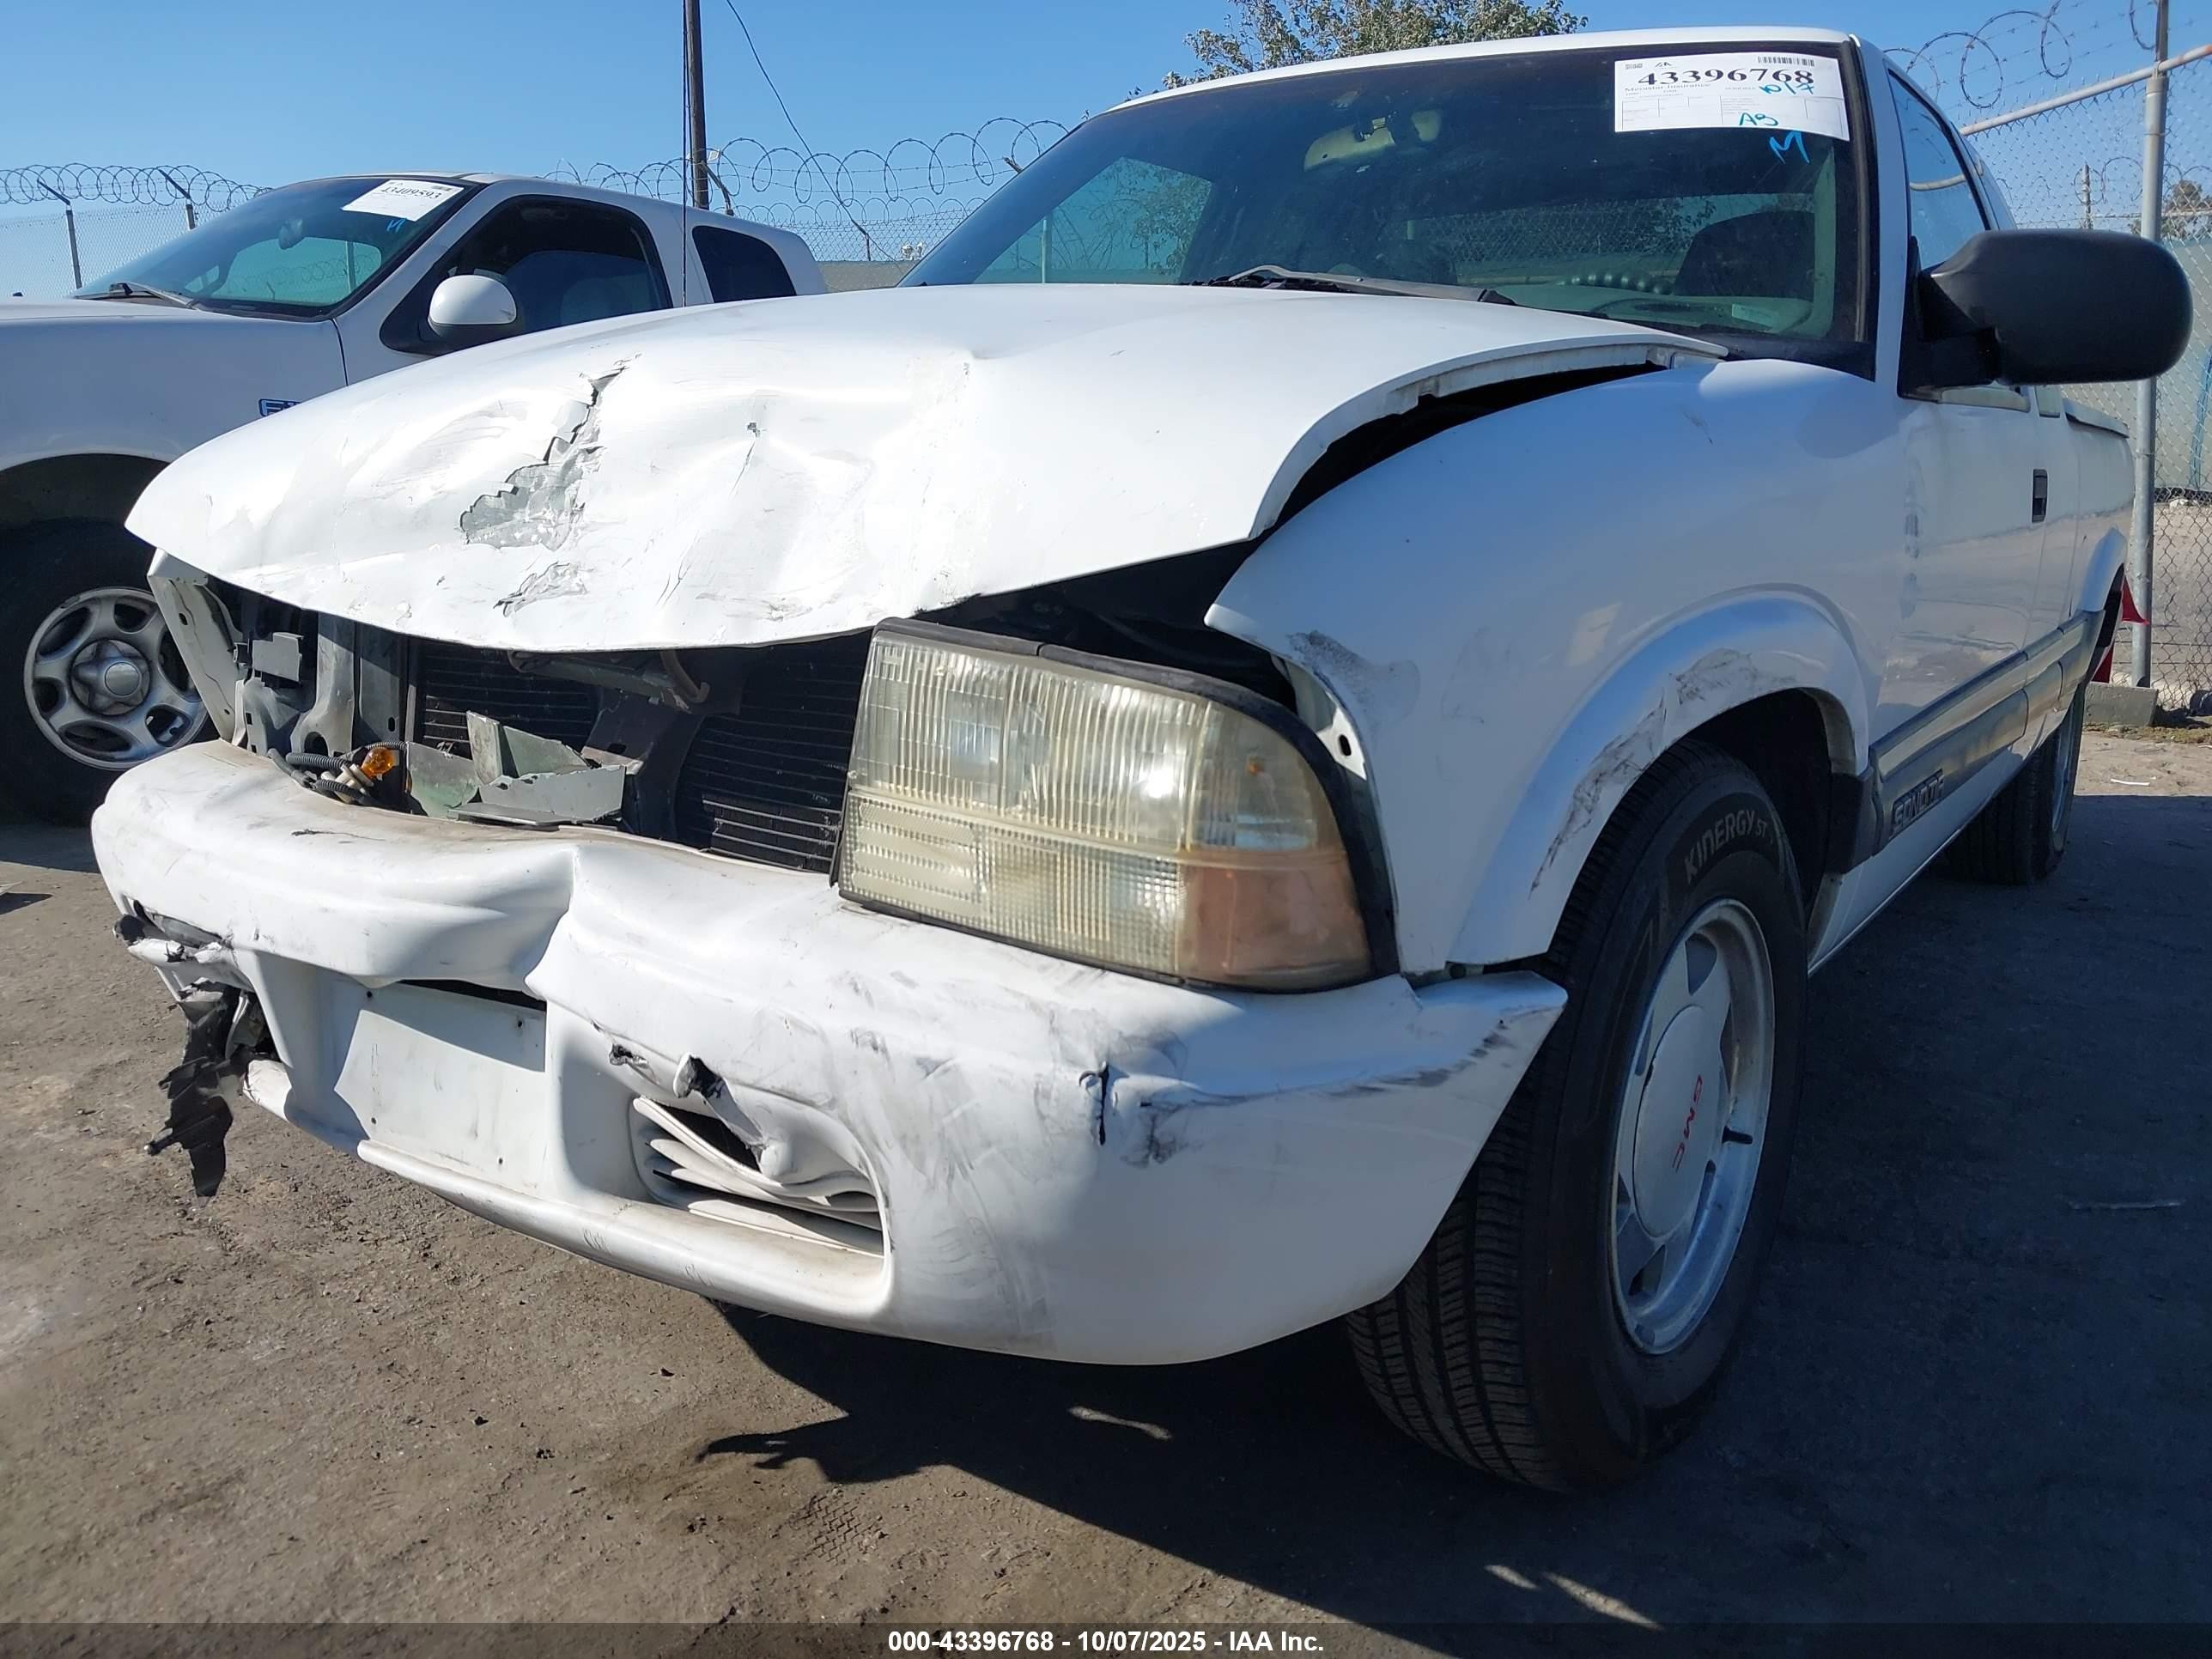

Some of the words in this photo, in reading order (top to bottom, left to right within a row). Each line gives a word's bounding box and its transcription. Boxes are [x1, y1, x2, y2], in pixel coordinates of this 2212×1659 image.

[1638, 67, 1814, 85] 43396768
[380, 185, 442, 199] 43409593
[1684, 810, 1755, 885] KINERGY
[1672, 1074, 1703, 1174] GMC
